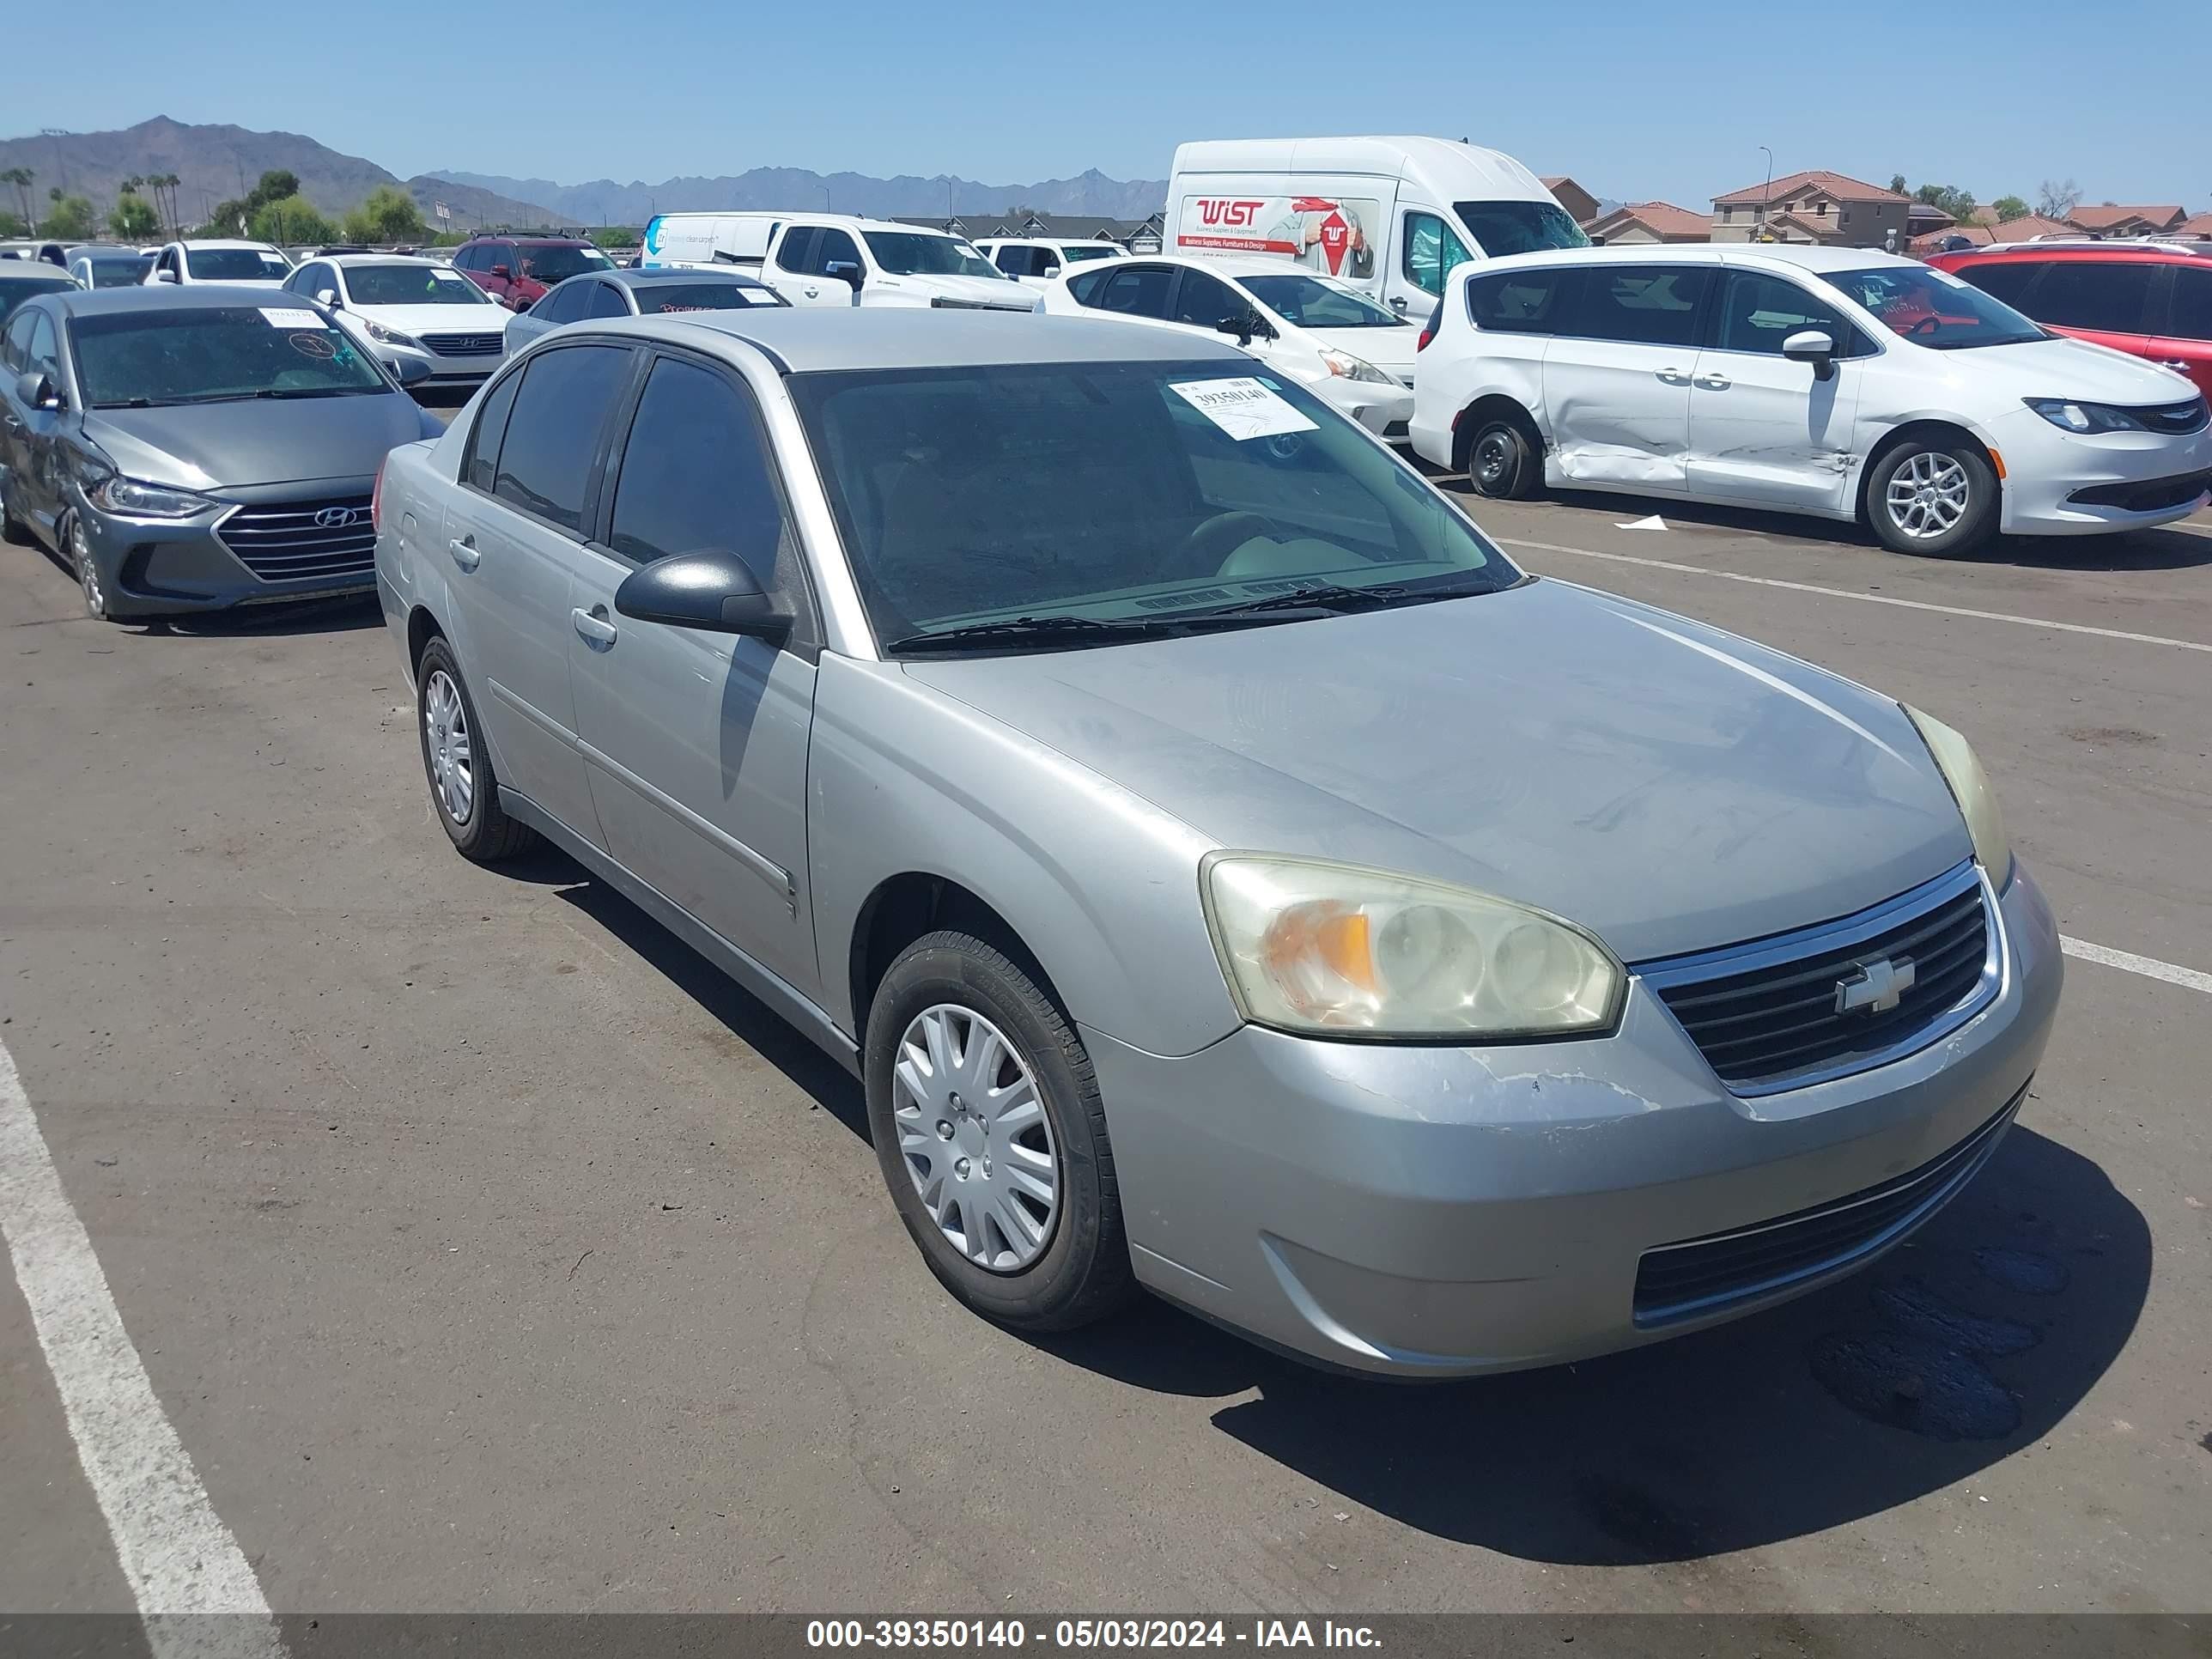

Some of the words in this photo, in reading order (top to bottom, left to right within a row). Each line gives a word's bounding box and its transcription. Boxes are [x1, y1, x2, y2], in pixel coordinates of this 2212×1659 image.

[1222, 240, 1243, 248] Furniture
[1249, 241, 1267, 250] Design
[1195, 389, 1267, 406] 39350140
